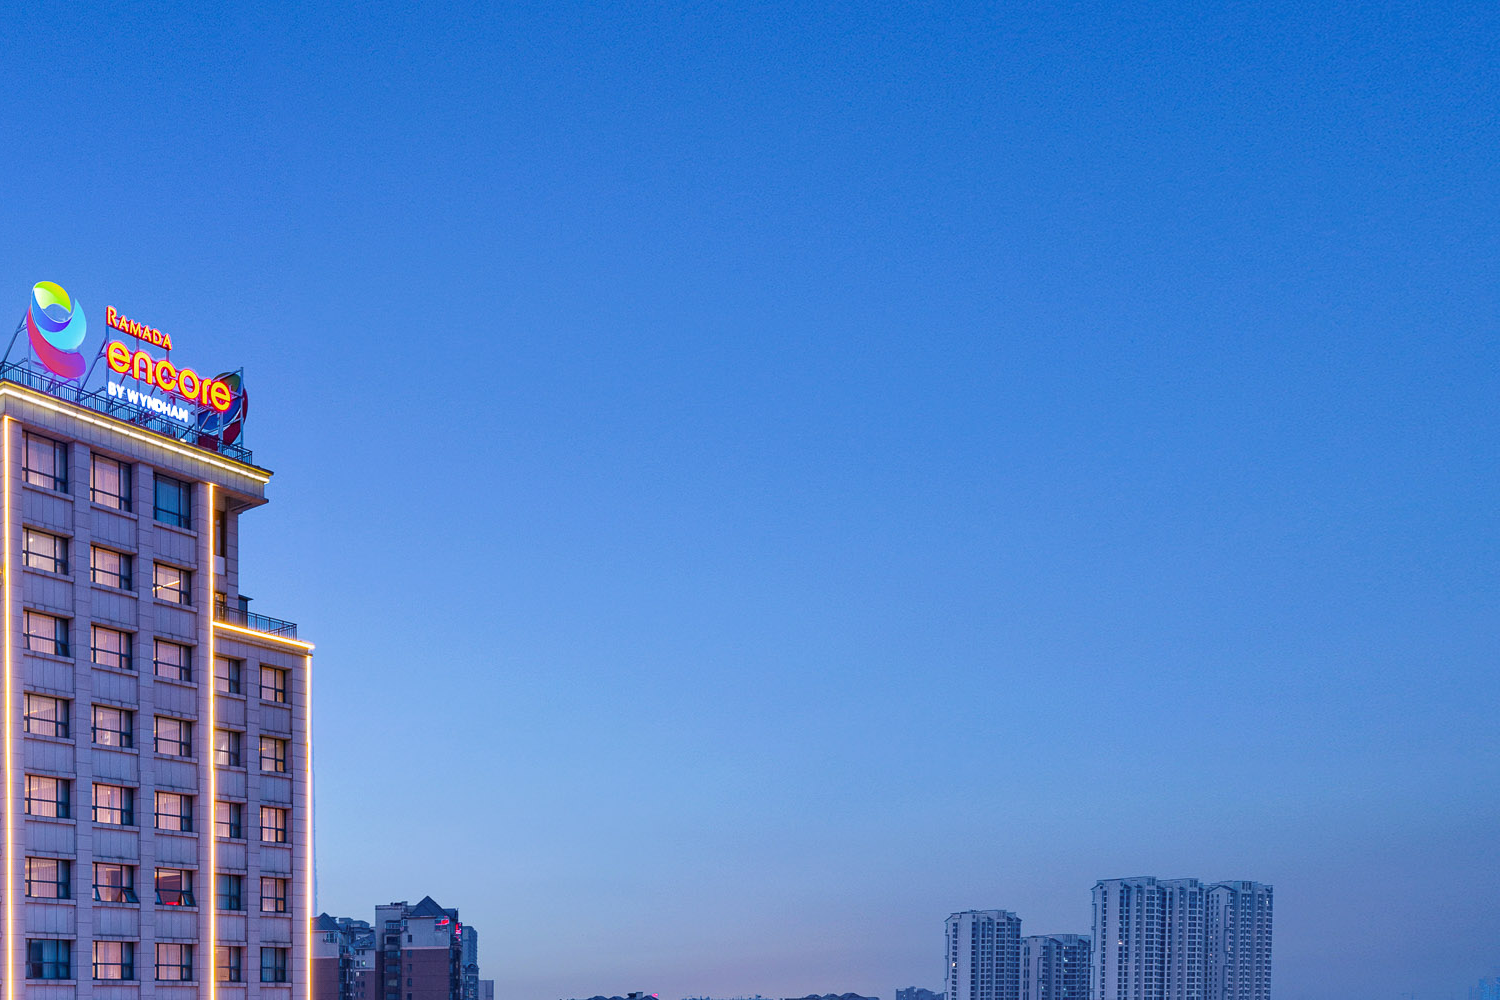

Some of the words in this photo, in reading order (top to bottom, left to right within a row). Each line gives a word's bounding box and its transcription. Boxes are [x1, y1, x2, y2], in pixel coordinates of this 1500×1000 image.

[106, 306, 172, 350] RAMADA
[107, 341, 231, 411] encore
[107, 381, 125, 399] BY
[127, 388, 189, 423] WYNDHAM
